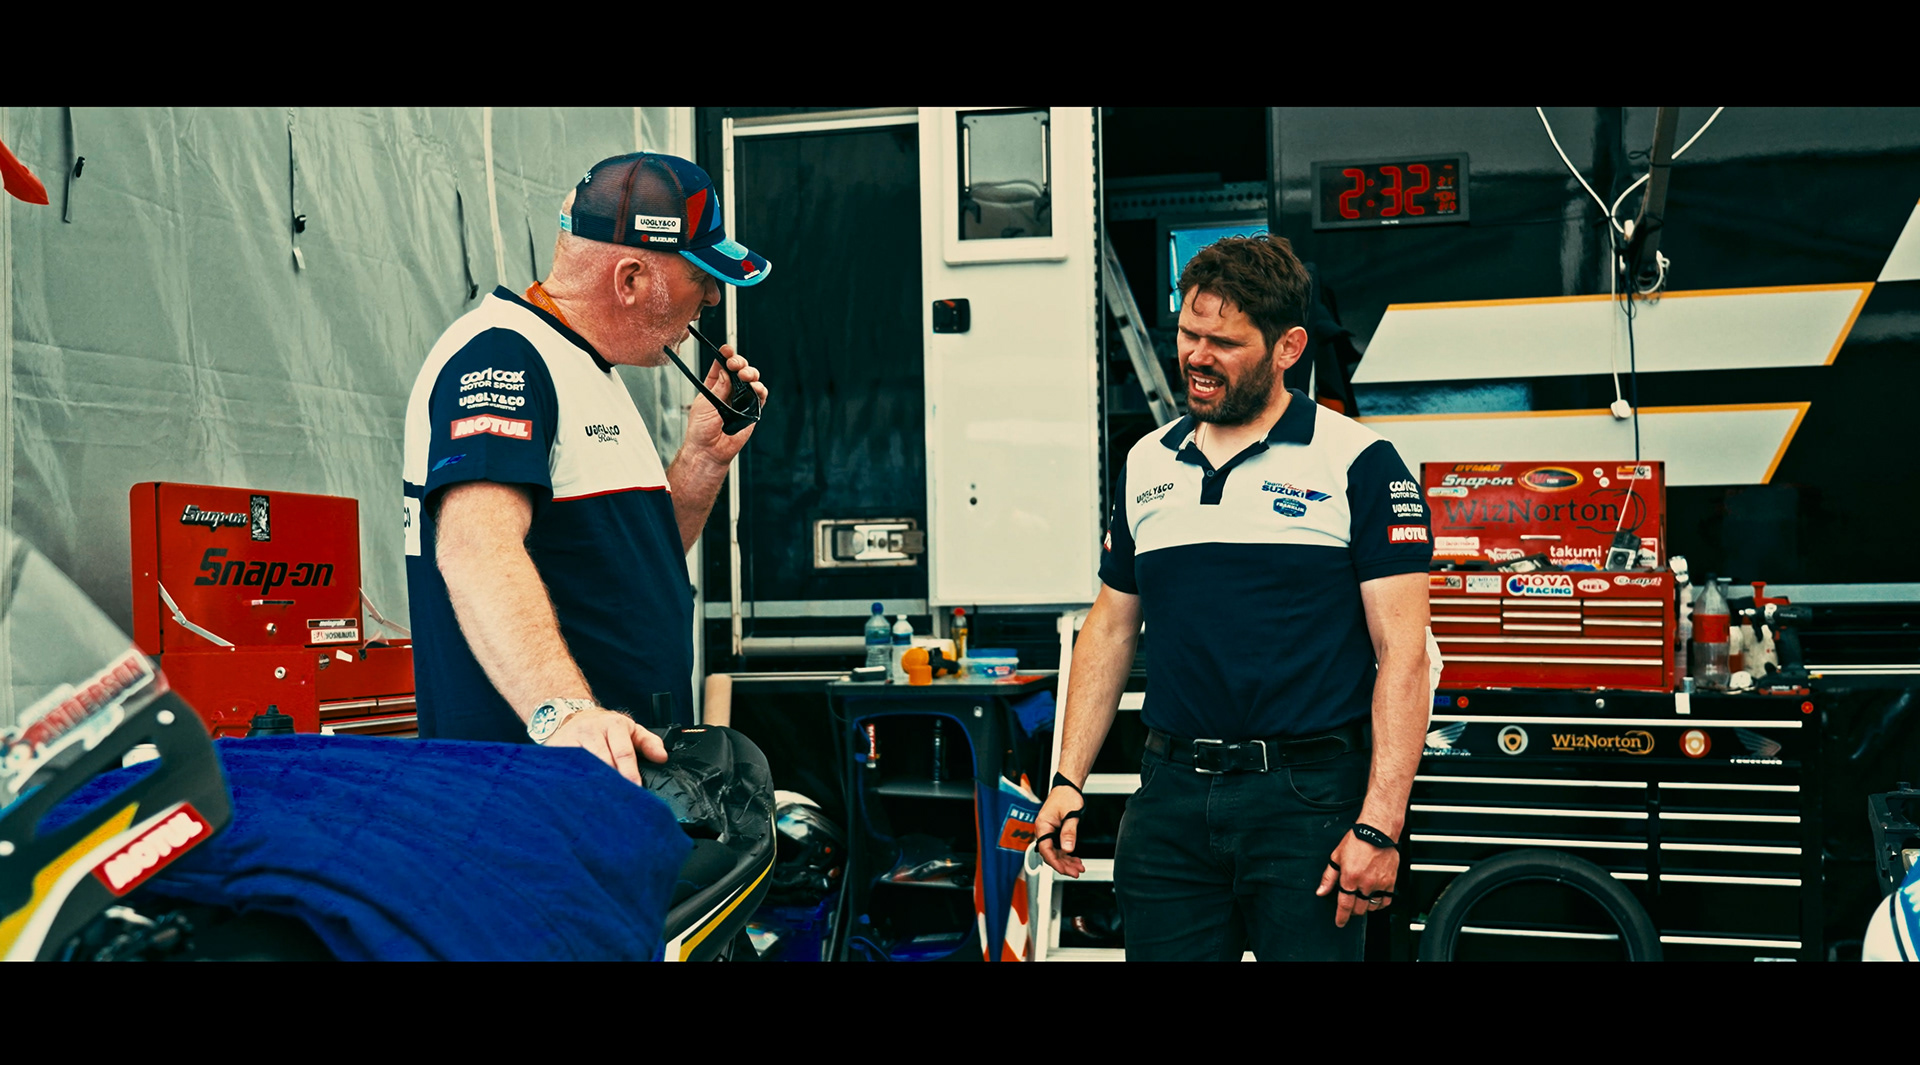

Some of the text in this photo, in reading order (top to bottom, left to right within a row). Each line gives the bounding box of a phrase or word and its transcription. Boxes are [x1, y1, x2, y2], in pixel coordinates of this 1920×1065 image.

[1339, 164, 1430, 219] 2:32
[649, 235, 678, 243] SUZUKI
[460, 380, 526, 393] MOTOR SPORT
[454, 416, 529, 437] MOTUL
[1441, 473, 1514, 489] Snap-on
[1261, 484, 1305, 499] SUZUKI
[180, 504, 249, 530] Snap-on
[1442, 498, 1620, 522] WizNorton
[1549, 545, 1602, 557] takumi
[194, 547, 334, 596] Snap-on
[1517, 577, 1571, 586] NOVA
[1526, 587, 1571, 595] RACING
[1551, 733, 1641, 748] WizNorton
[104, 811, 203, 890] MOTUL
